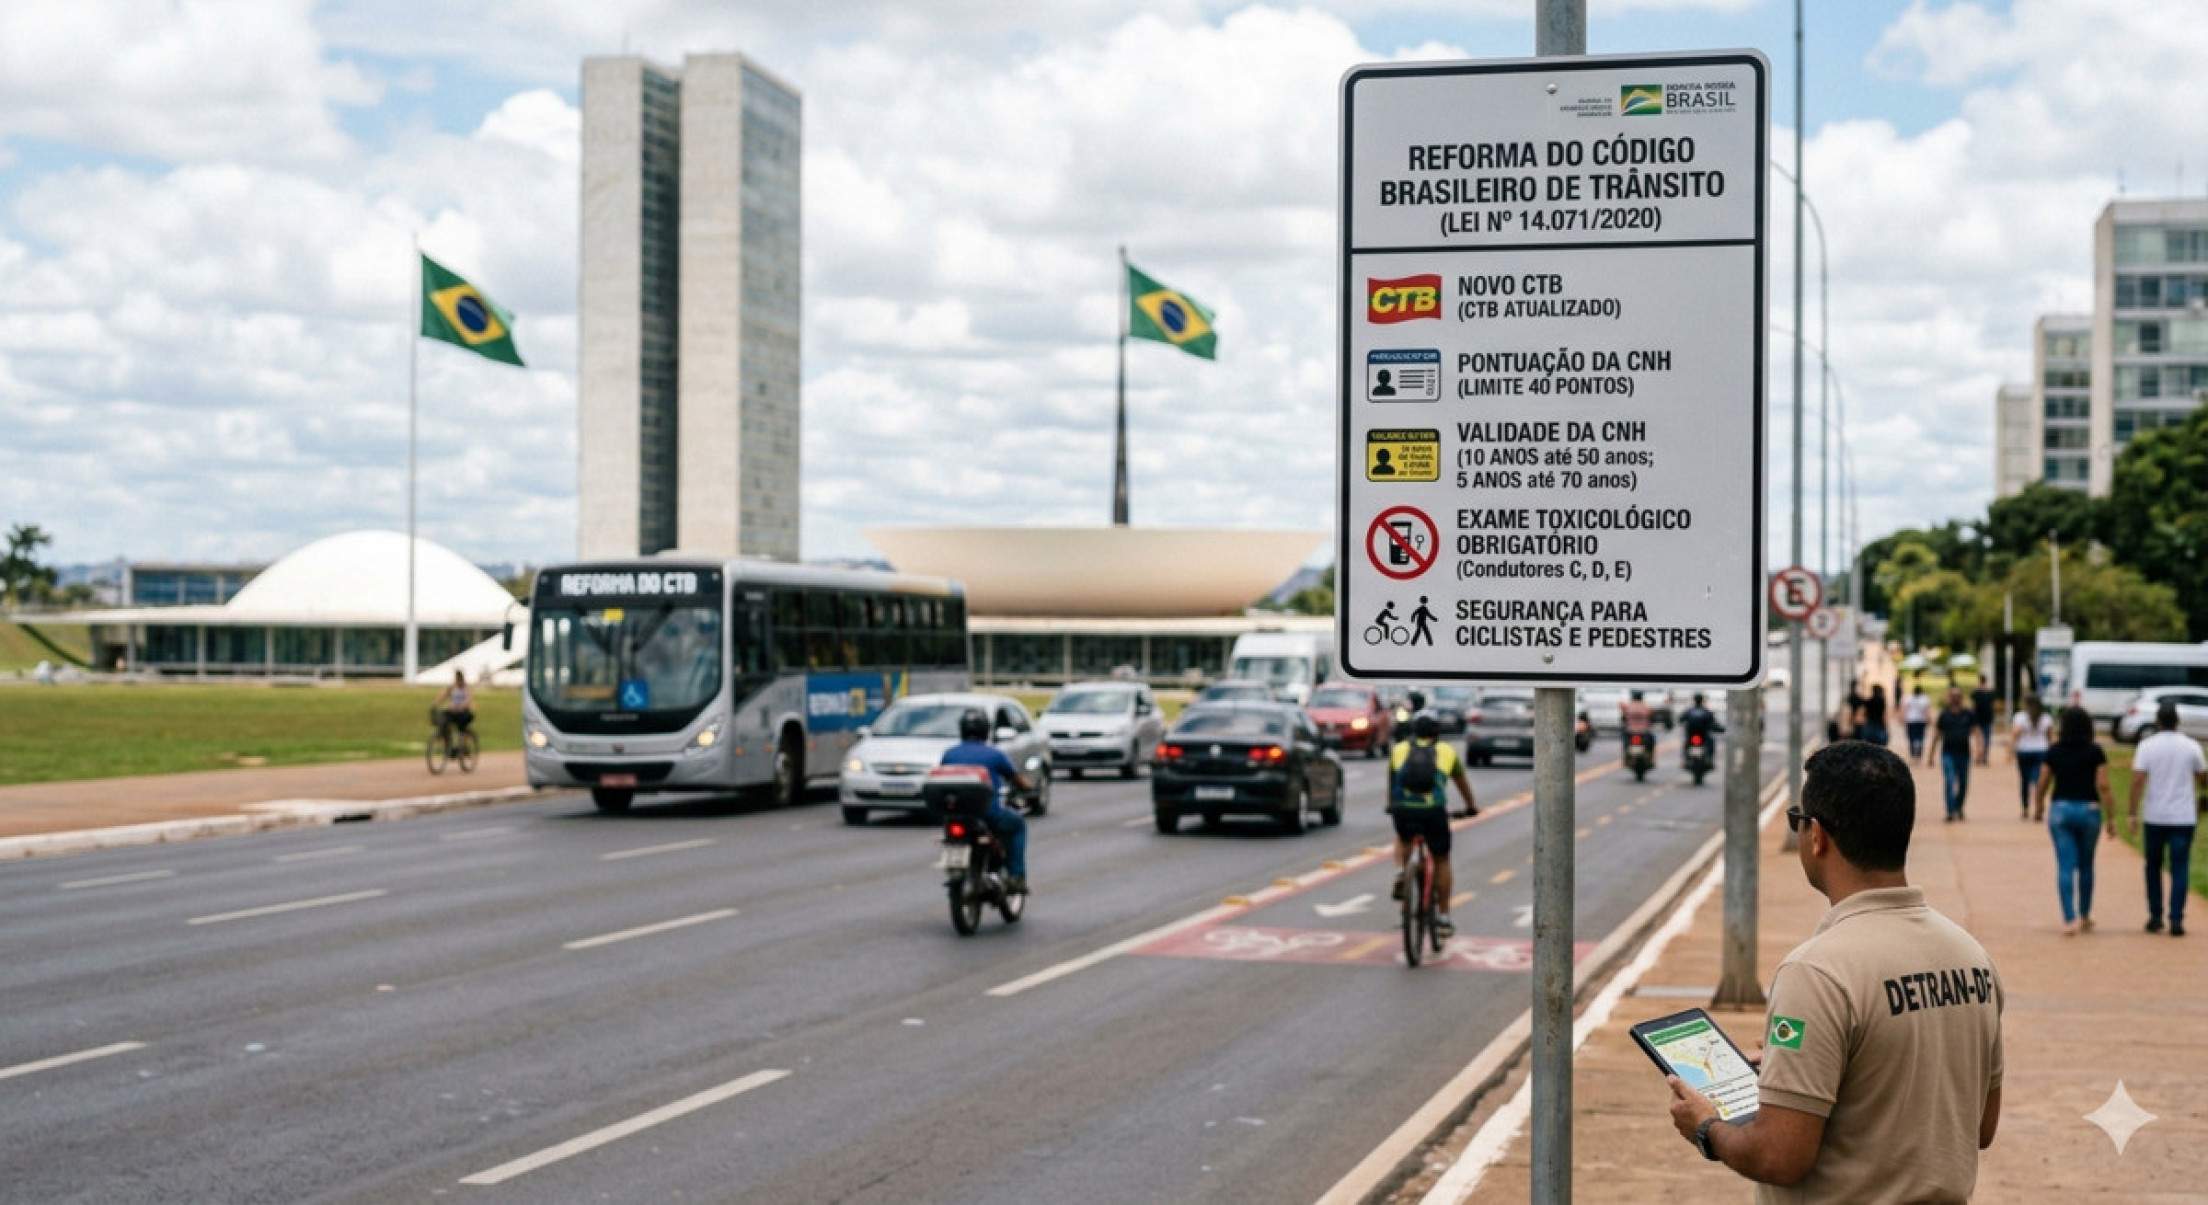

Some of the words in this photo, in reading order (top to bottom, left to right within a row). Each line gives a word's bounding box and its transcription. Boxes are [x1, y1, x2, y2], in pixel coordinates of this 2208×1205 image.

[1666, 91, 1737, 109] BRASIL
[1408, 141, 1538, 172] REFORMA
[1546, 140, 1584, 167] DO
[1592, 132, 1695, 166] CÓDIGO
[1380, 176, 1537, 206] BRASILEIRO
[1546, 174, 1581, 202] DE
[1588, 166, 1725, 200] TRÂNSITO
[1440, 211, 1480, 238] (LEI
[1487, 210, 1513, 233] Nº
[1519, 205, 1663, 233] 14.071/2020)
[1458, 275, 1516, 297] NOVO
[1521, 273, 1564, 296] CTB
[1371, 286, 1437, 314] CTB
[1458, 300, 1500, 323] (CTB
[1503, 297, 1622, 321] ATUALIZADO)
[1458, 347, 1586, 376] PONTUAÇÃO
[1592, 351, 1622, 373] DA
[1627, 350, 1673, 372] CNH
[1457, 377, 1524, 400] (LIMITE
[1528, 377, 1551, 396] 40
[1555, 376, 1635, 398] PONTOS)
[1456, 421, 1561, 443] VALIDADE
[1567, 421, 1597, 443] DA
[1601, 420, 1647, 442] CNH
[1456, 448, 1486, 469] (10
[1489, 446, 1540, 466] ANOS
[1543, 446, 1574, 466] até
[1576, 447, 1600, 466] 50
[1604, 448, 1655, 468] anos;
[1456, 470, 1468, 489] 5
[1471, 470, 1523, 489] ANOS
[1526, 469, 1556, 489] até
[1560, 470, 1584, 489] 70
[1587, 470, 1638, 492] anos)
[1456, 508, 1530, 530] EXAME
[1535, 503, 1693, 530] TOXICOLÓGICO
[1456, 528, 1599, 556] OBRIGATÓRIO
[1456, 558, 1566, 581] (Condutores
[1569, 559, 1588, 582] C,
[1591, 560, 1611, 582] D,
[1614, 560, 1633, 583] E)
[1455, 599, 1586, 627] SEGURANÇA
[1591, 600, 1649, 623] PARA
[1455, 625, 1564, 648] CICLISTAS
[1569, 626, 1583, 648] E
[1587, 626, 1713, 650] PEDESTRES
[1883, 966, 1992, 1016] DETRAN-DF
